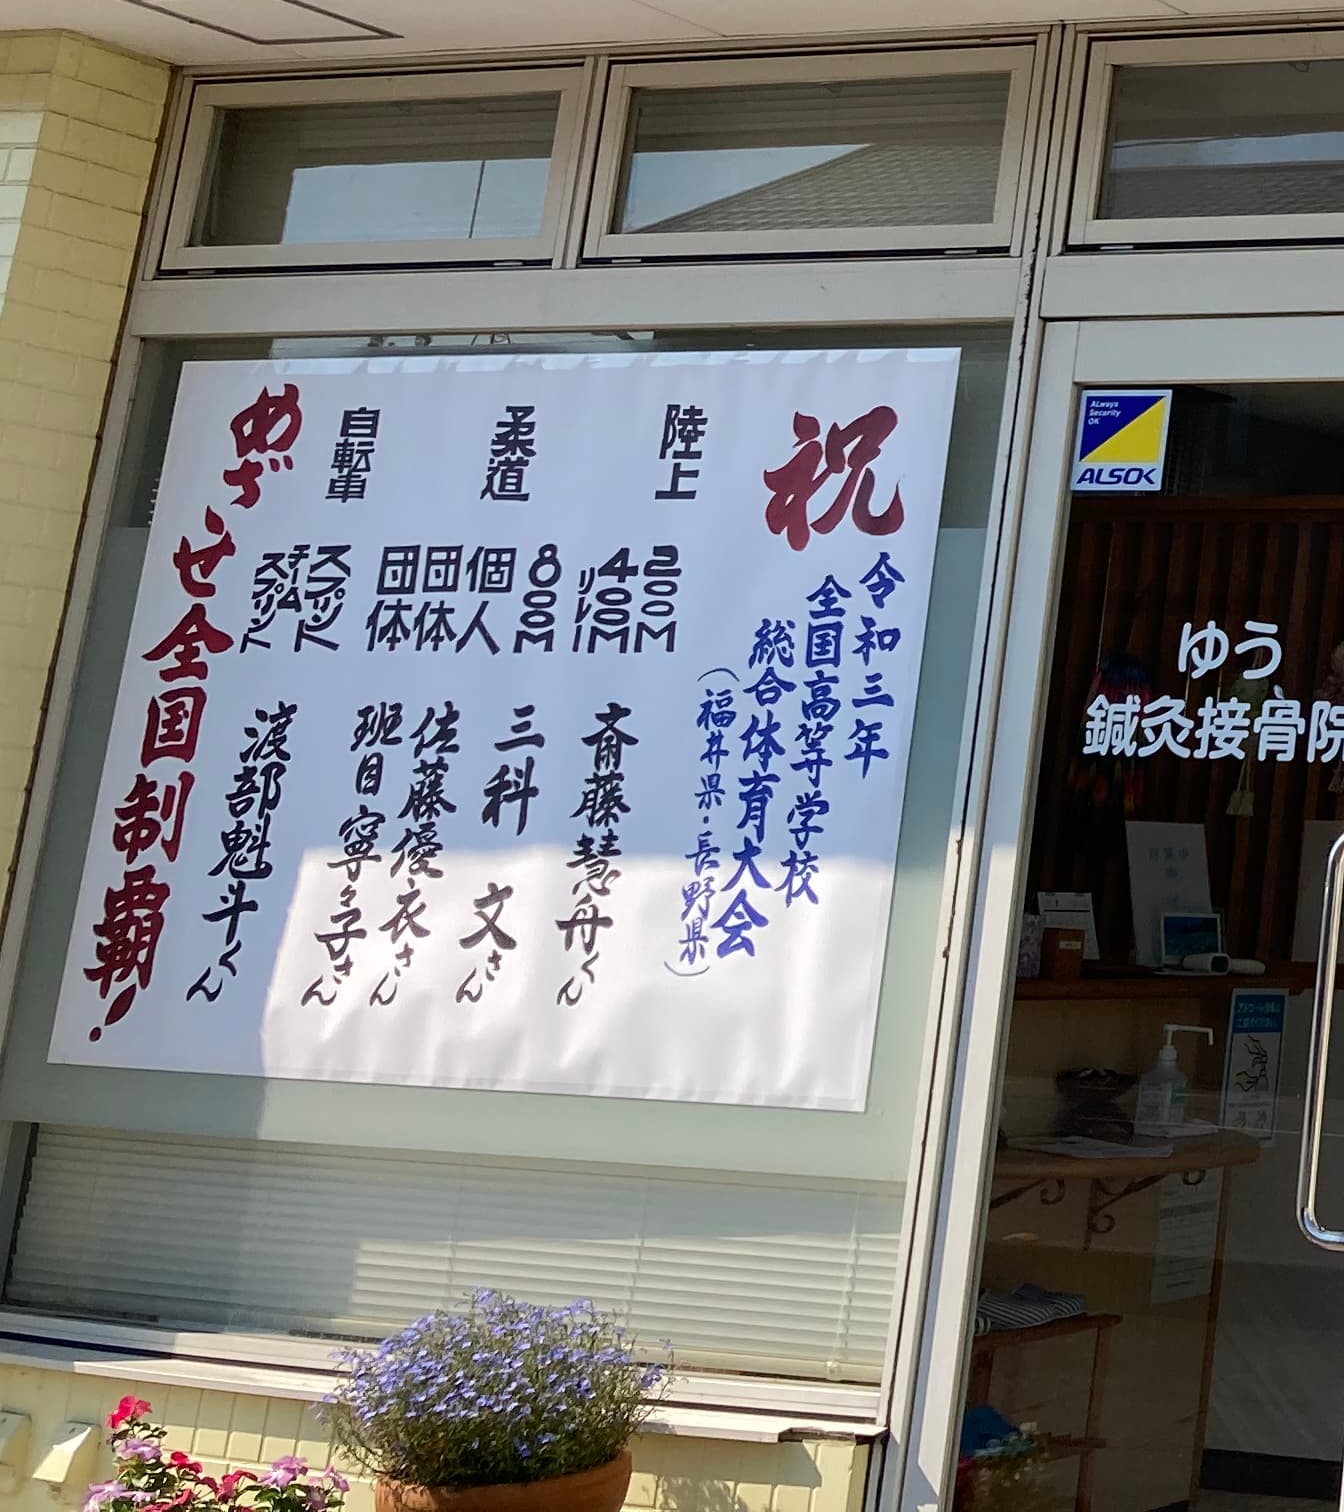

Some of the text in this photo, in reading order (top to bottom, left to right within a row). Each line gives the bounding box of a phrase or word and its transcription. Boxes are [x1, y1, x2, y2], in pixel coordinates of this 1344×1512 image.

[325, 406, 381, 503] 自転車
[479, 405, 537, 502] 柔道
[655, 404, 708, 501] 陸上
[1087, 417, 1100, 425] OK
[1088, 409, 1122, 418] Security
[763, 405, 905, 551] 祝
[1076, 467, 1157, 485] ALSOK
[366, 544, 421, 652] 団体
[414, 544, 464, 652] 団体
[455, 546, 517, 655] 個人
[513, 543, 562, 654] 800M
[587, 547, 639, 654] 400M
[633, 544, 682, 653] 200M
[1177, 619, 1283, 679] ゆう
[843, 551, 906, 779] 令和三年
[711, 618, 797, 960] 総合体育大会
[774, 574, 852, 908] 全国高等学校
